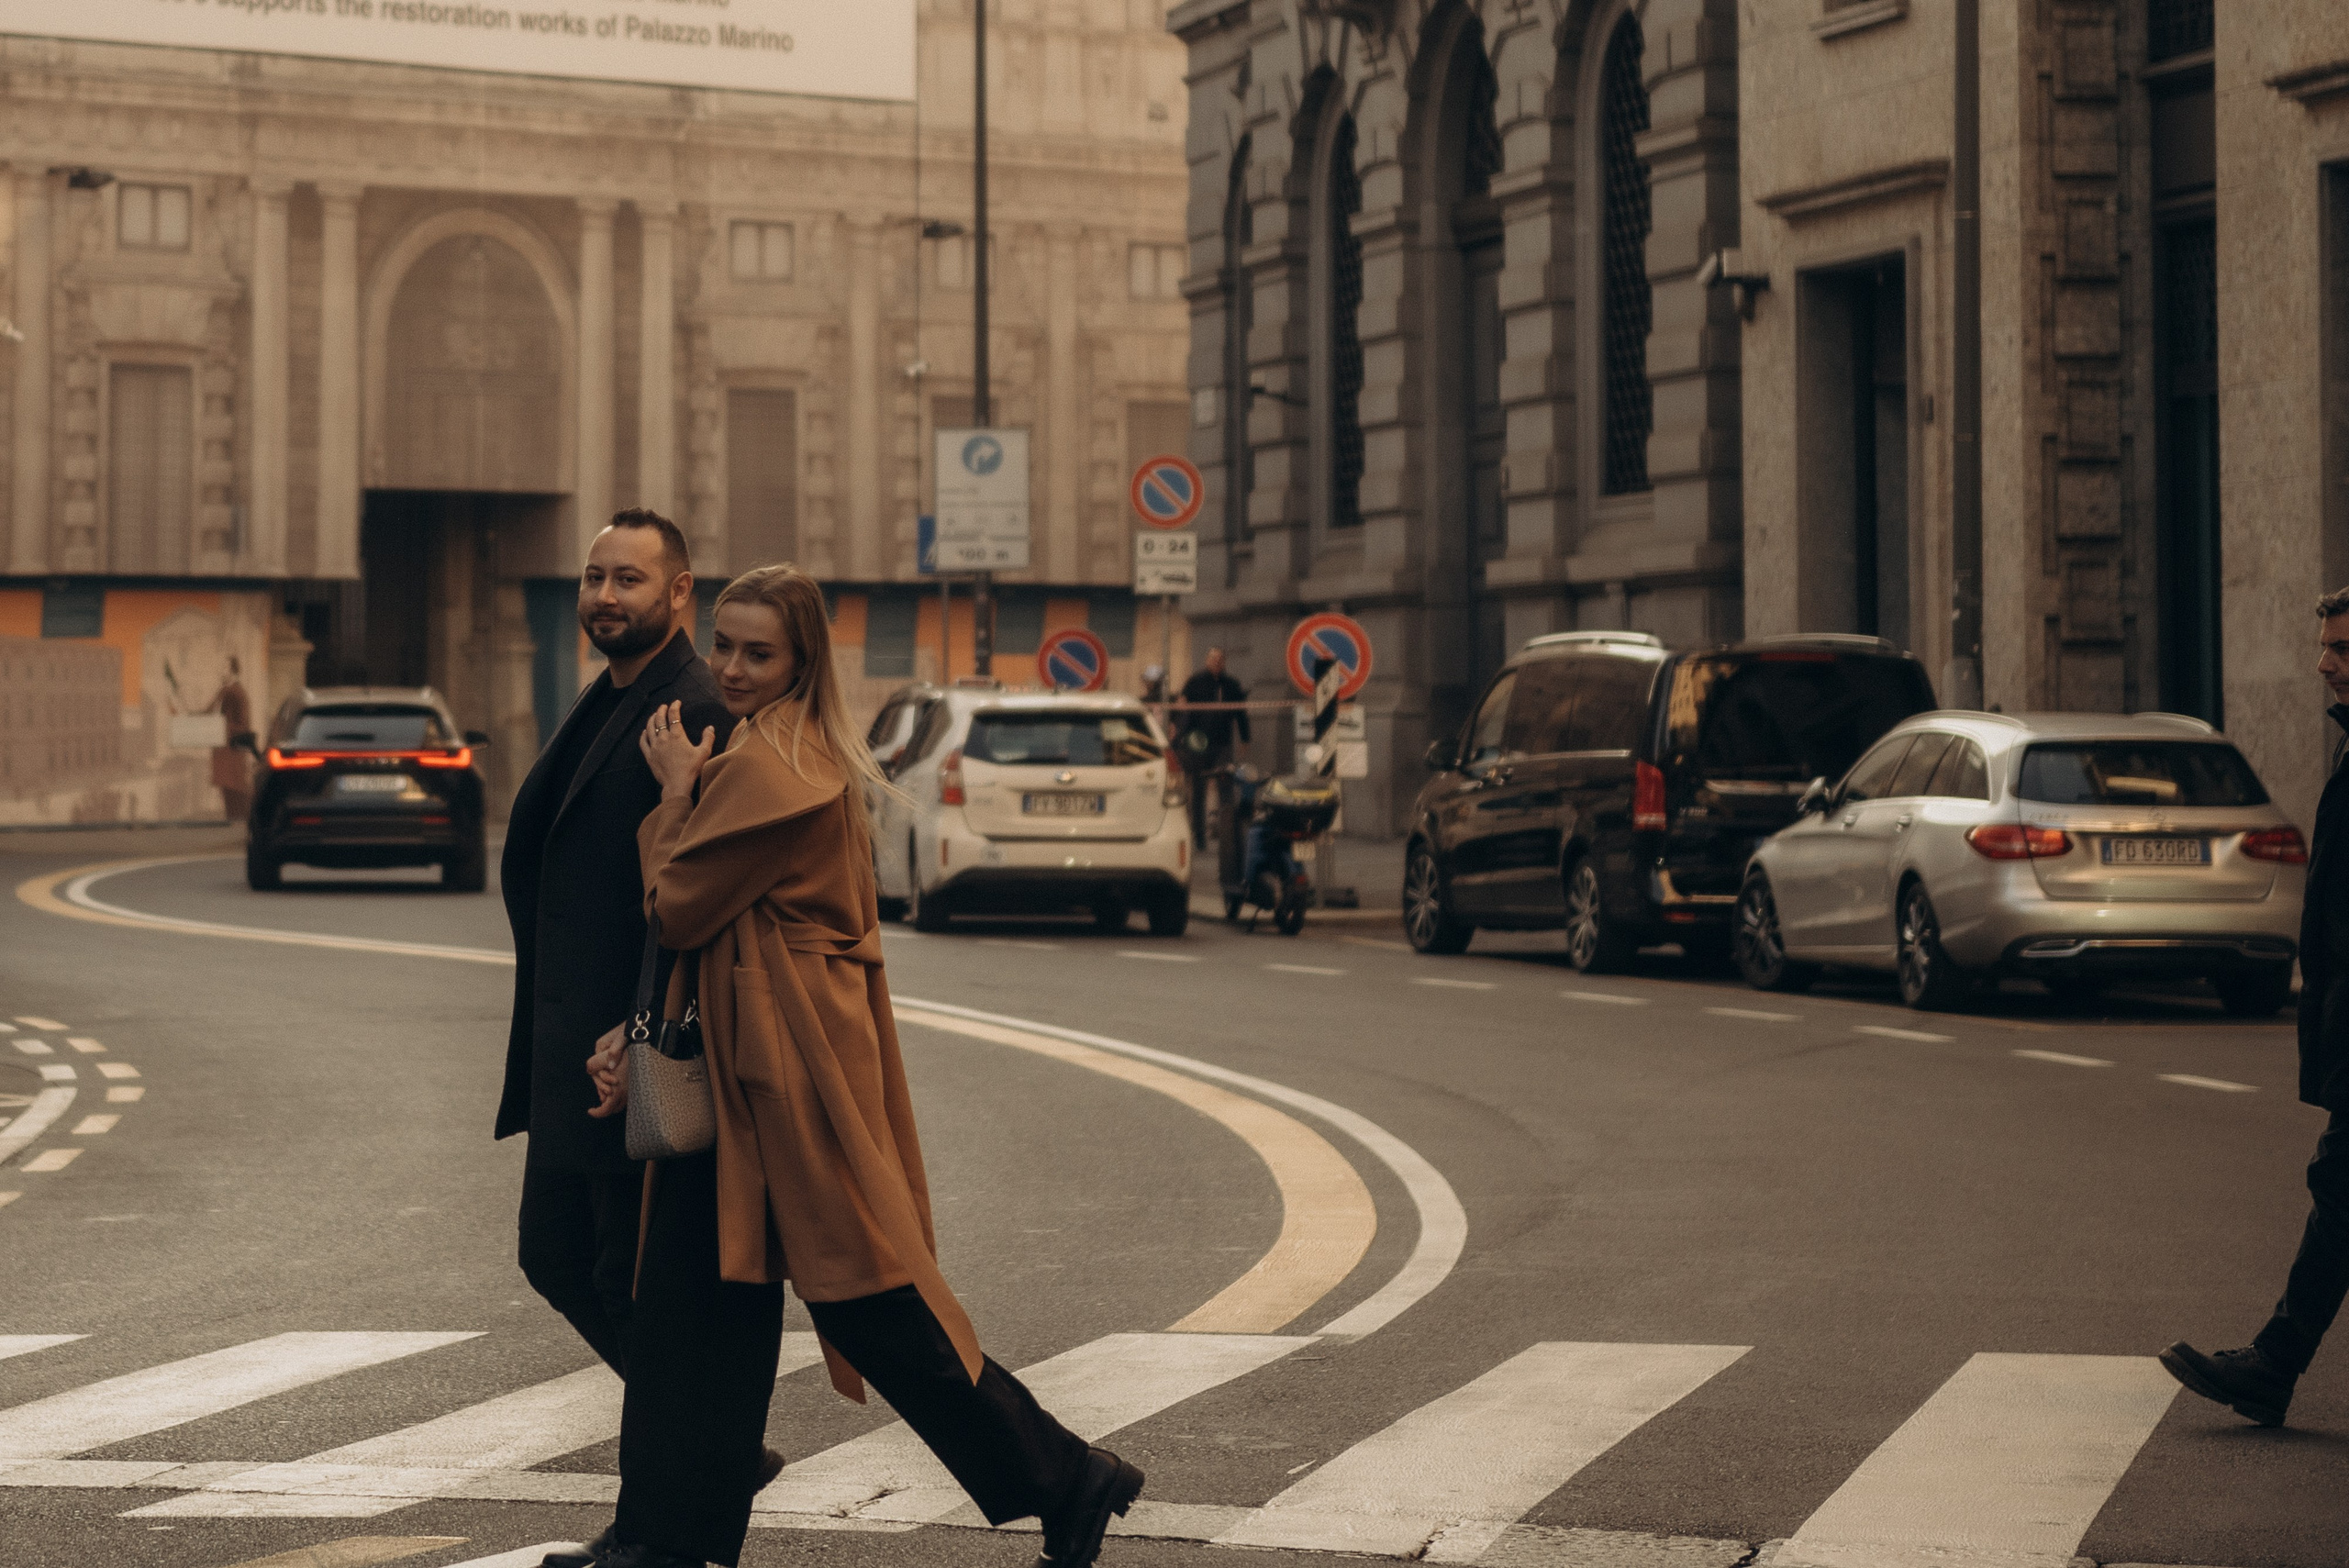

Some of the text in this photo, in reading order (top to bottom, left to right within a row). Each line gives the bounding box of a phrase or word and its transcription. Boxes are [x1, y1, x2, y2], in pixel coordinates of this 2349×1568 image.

[334, 0, 372, 18] the
[381, 1, 511, 28] restoration
[518, 12, 588, 36] works
[596, 15, 618, 38] of
[625, 15, 711, 45] Palazzo
[718, 23, 794, 52] Marino
